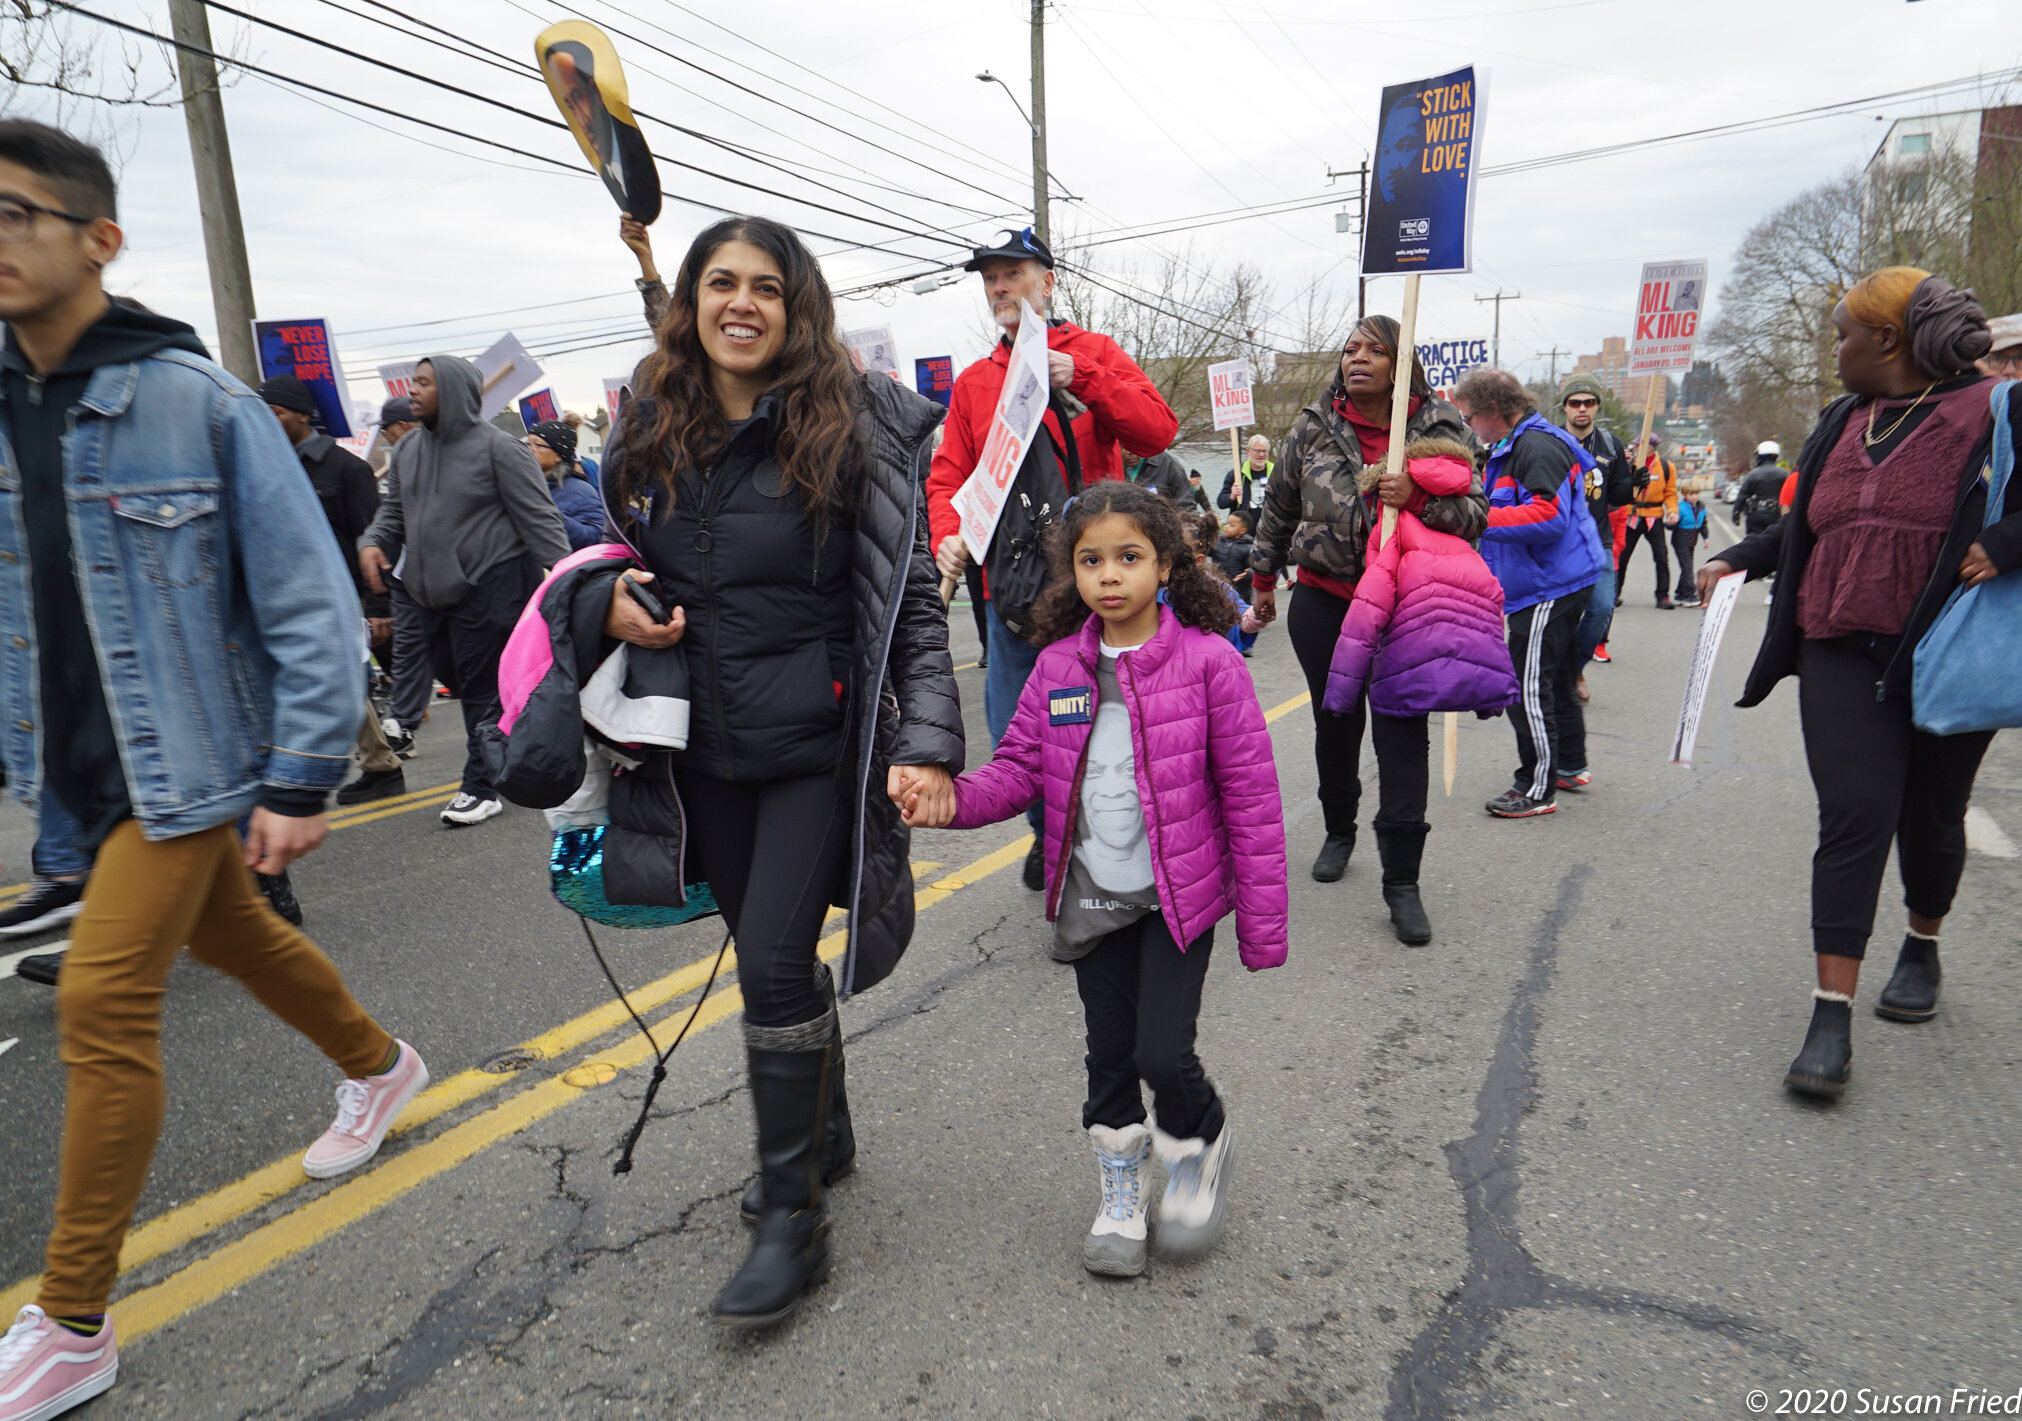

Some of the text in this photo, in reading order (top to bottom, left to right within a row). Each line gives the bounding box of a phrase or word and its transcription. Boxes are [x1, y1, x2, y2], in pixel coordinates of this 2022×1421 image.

[1425, 111, 1472, 144] WITH
[1421, 142, 1468, 178] LOVE.
[1636, 311, 1698, 341] KING
[294, 344, 329, 363] LOSE
[1634, 343, 1692, 356] ALL ARE WELCOME
[1632, 359, 1660, 370] JANUARY
[1215, 388, 1250, 408] KING
